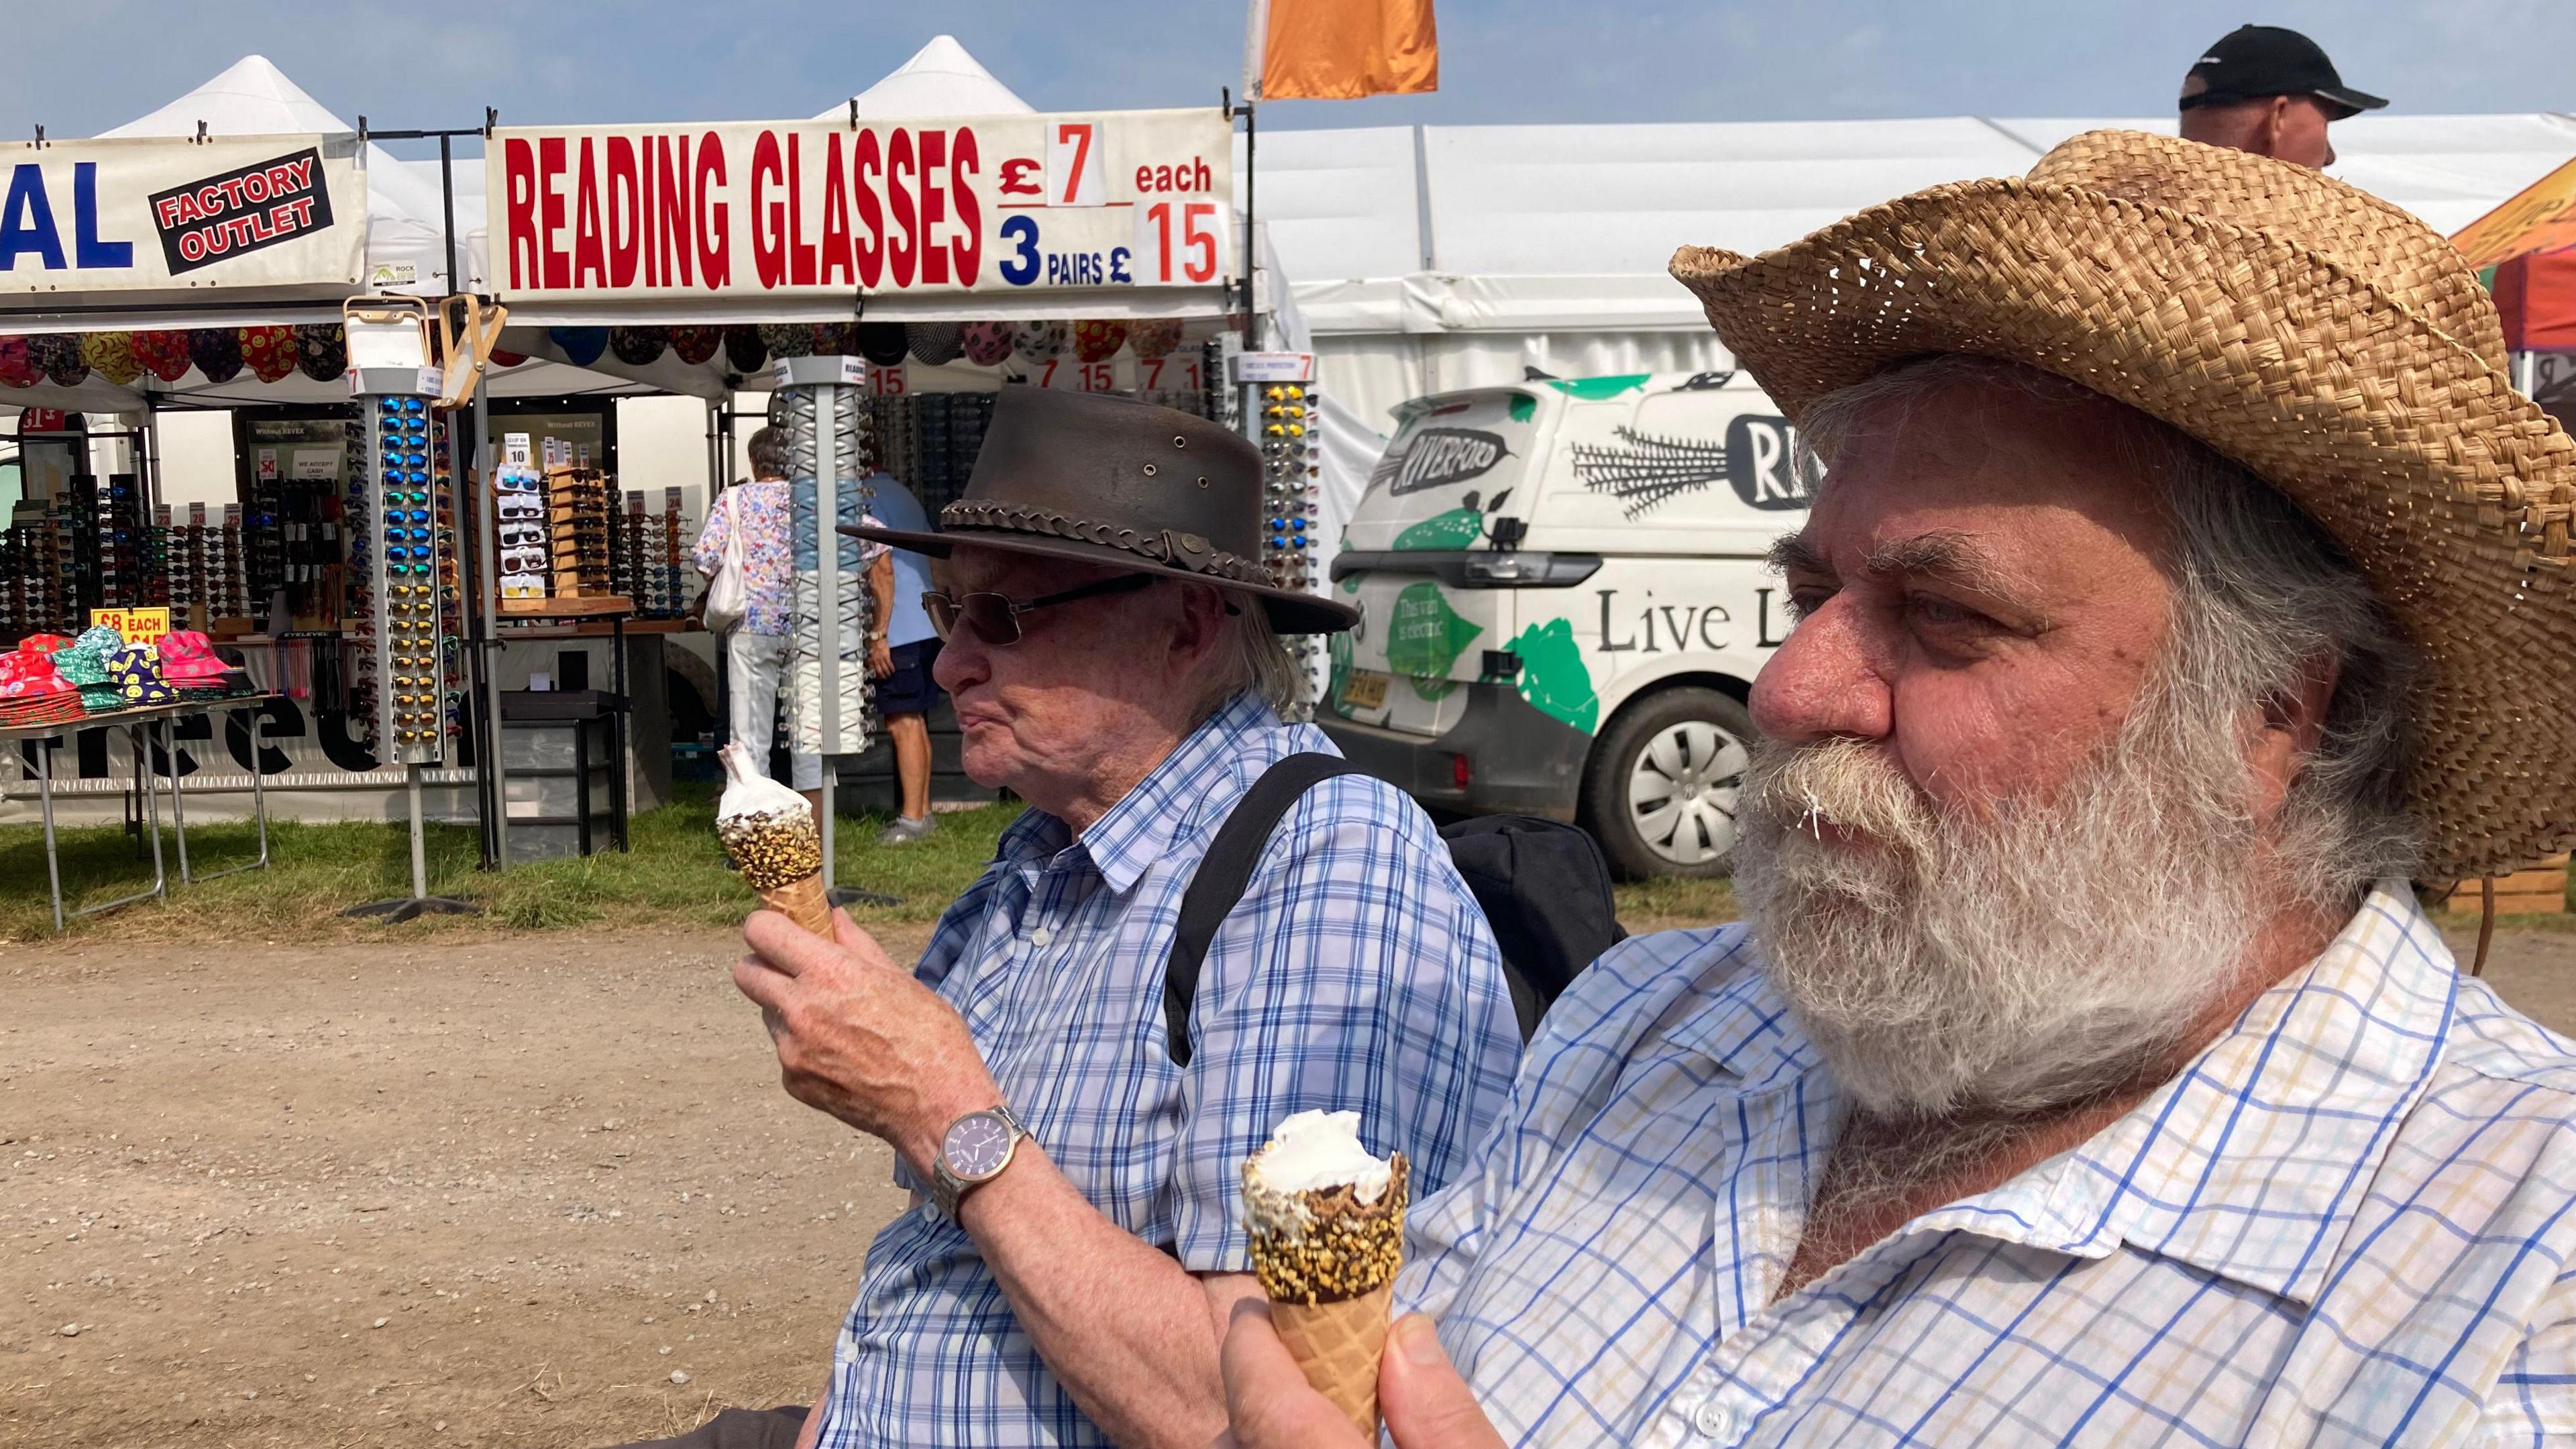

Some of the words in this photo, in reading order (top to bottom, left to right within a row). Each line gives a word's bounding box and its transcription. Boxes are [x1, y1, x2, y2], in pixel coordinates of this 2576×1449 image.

[999, 158, 1042, 195] £
[1059, 124, 1092, 203] 7
[1136, 156, 1211, 193] each
[156, 156, 314, 229] FACTORY
[505, 131, 731, 290] READING
[751, 127, 981, 290] GLASSES
[179, 196, 315, 262] OUTLET
[1000, 215, 1040, 286] 3
[1049, 253, 1103, 285] PAIRS
[1110, 247, 1132, 284] £
[1148, 203, 1216, 283] 15
[349, 368, 358, 393] 7
[870, 368, 904, 395] 15
[1079, 364, 1113, 392] 15
[1142, 359, 1165, 390] 7
[1300, 354, 1311, 379] 7
[511, 451, 525, 462] 10
[1393, 435, 1497, 490] RIVERFORD
[1747, 422, 1806, 502] RI
[227, 515, 239, 525] 25
[101, 613, 122, 631] £8
[128, 618, 160, 631] EACH
[1595, 589, 1731, 652] Live
[1754, 588, 1789, 648] L
